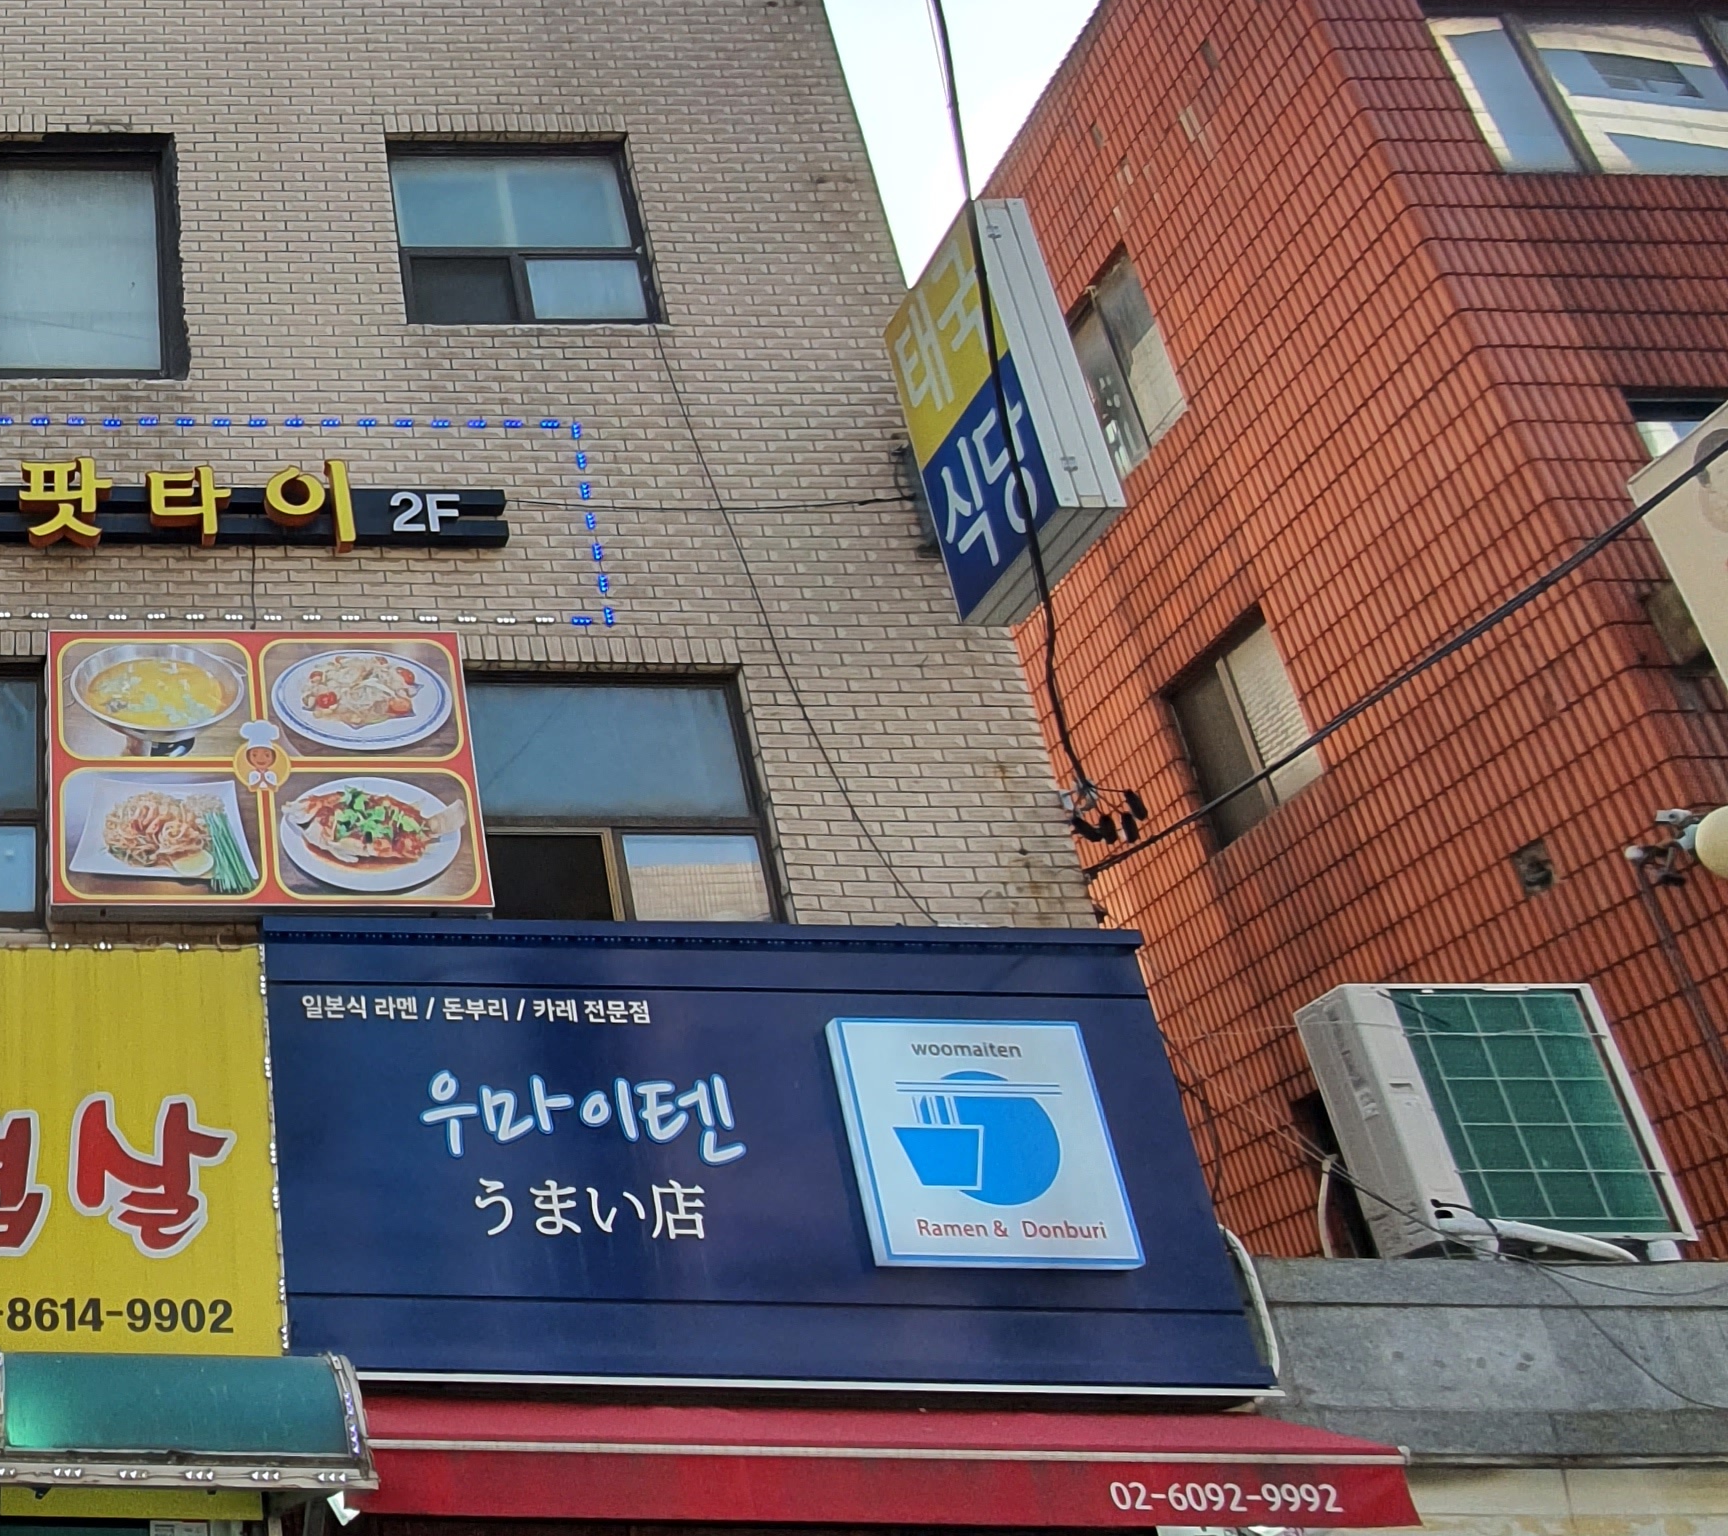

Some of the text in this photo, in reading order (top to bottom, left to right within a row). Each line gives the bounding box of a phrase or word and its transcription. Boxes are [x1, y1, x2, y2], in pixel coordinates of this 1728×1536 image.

[894, 238, 992, 412] 태국
[940, 386, 1040, 567] 식당
[388, 491, 462, 533] 2F
[301, 994, 368, 1022] 일본식
[374, 996, 418, 1023] 라멘
[441, 996, 509, 1024] 돈부리
[532, 998, 578, 1025] 카레
[583, 999, 652, 1026] 전문점
[910, 1038, 1023, 1061] woomaiten
[419, 1067, 749, 1168] 우마이텐
[474, 1178, 707, 1241] うまい店
[916, 1216, 989, 1240] Ramen
[1022, 1219, 1108, 1242] Donburi
[1109, 1479, 1345, 1515] 02-6092-9992
